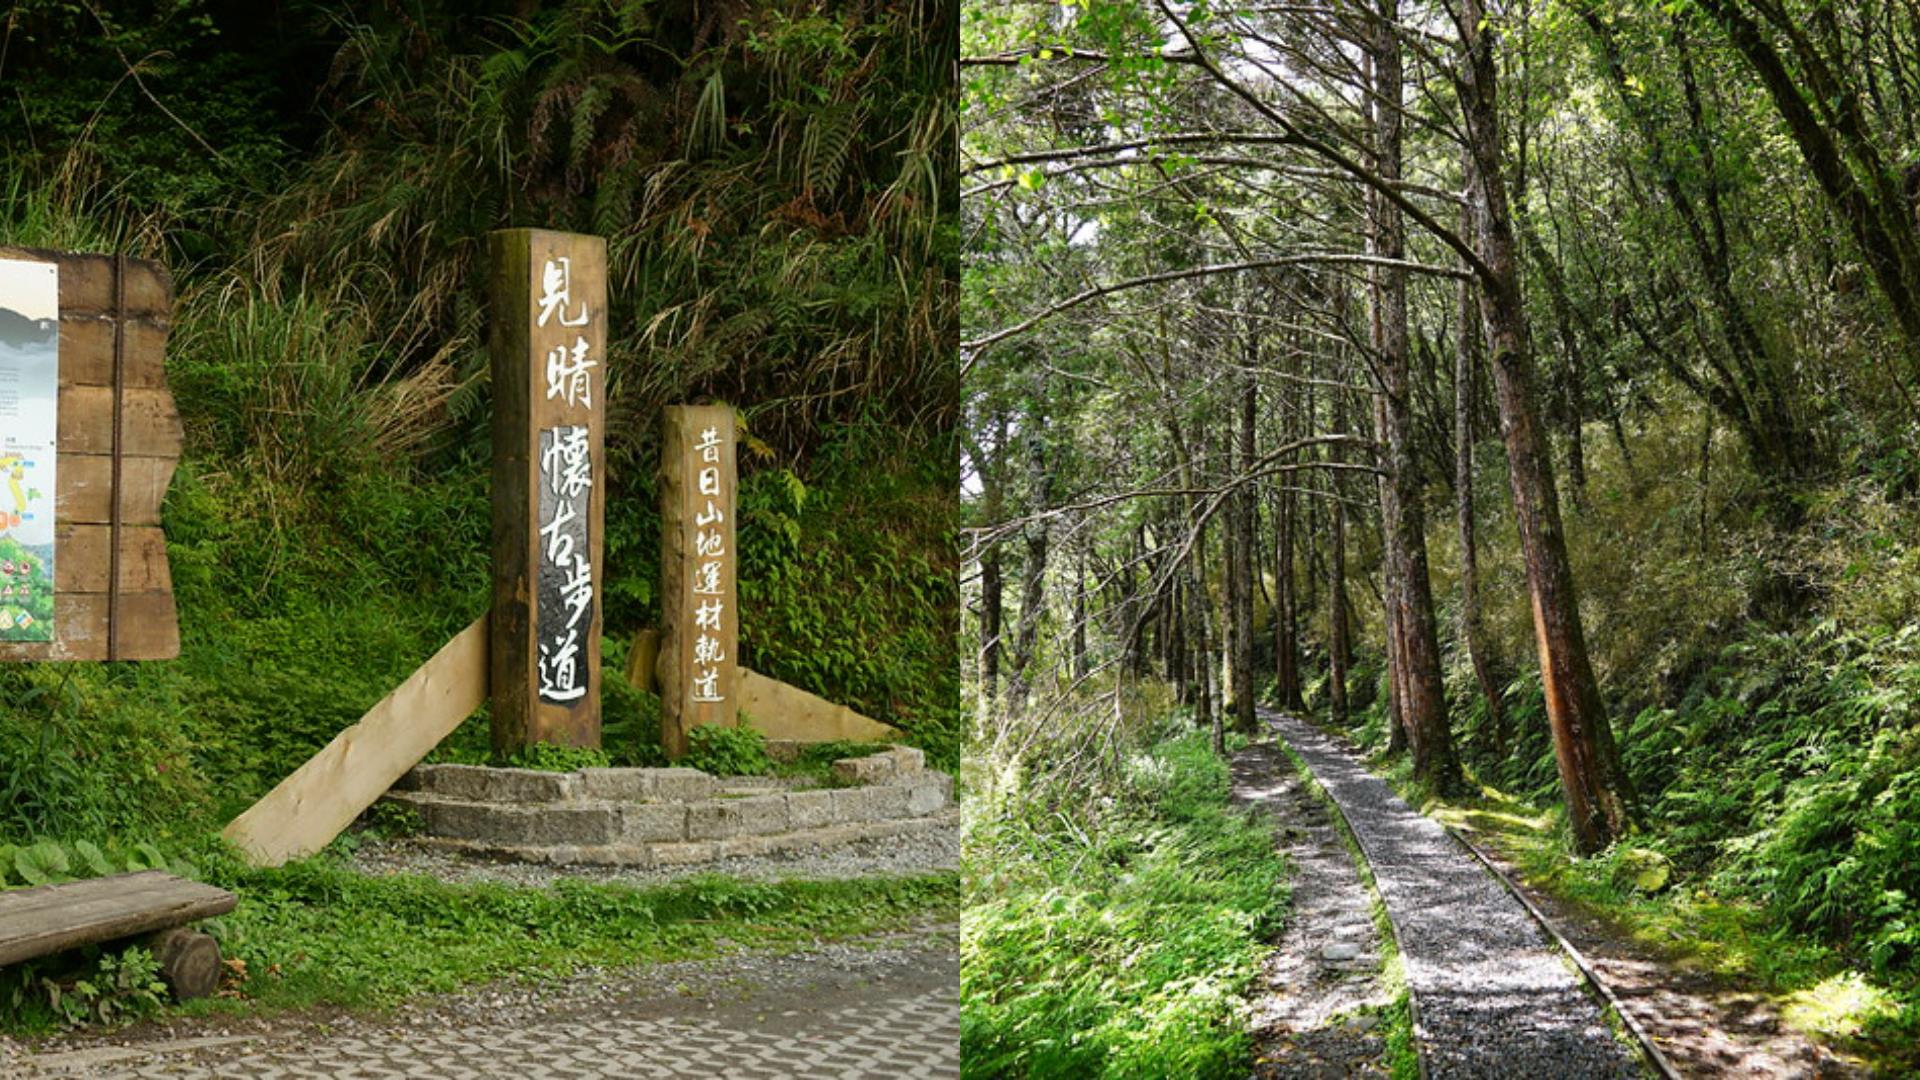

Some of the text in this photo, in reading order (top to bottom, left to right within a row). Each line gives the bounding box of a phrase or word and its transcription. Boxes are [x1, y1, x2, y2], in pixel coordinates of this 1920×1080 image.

[537, 256, 597, 701] 見晴懷古步道
[693, 426, 725, 702] 昔日山地運材軌道
